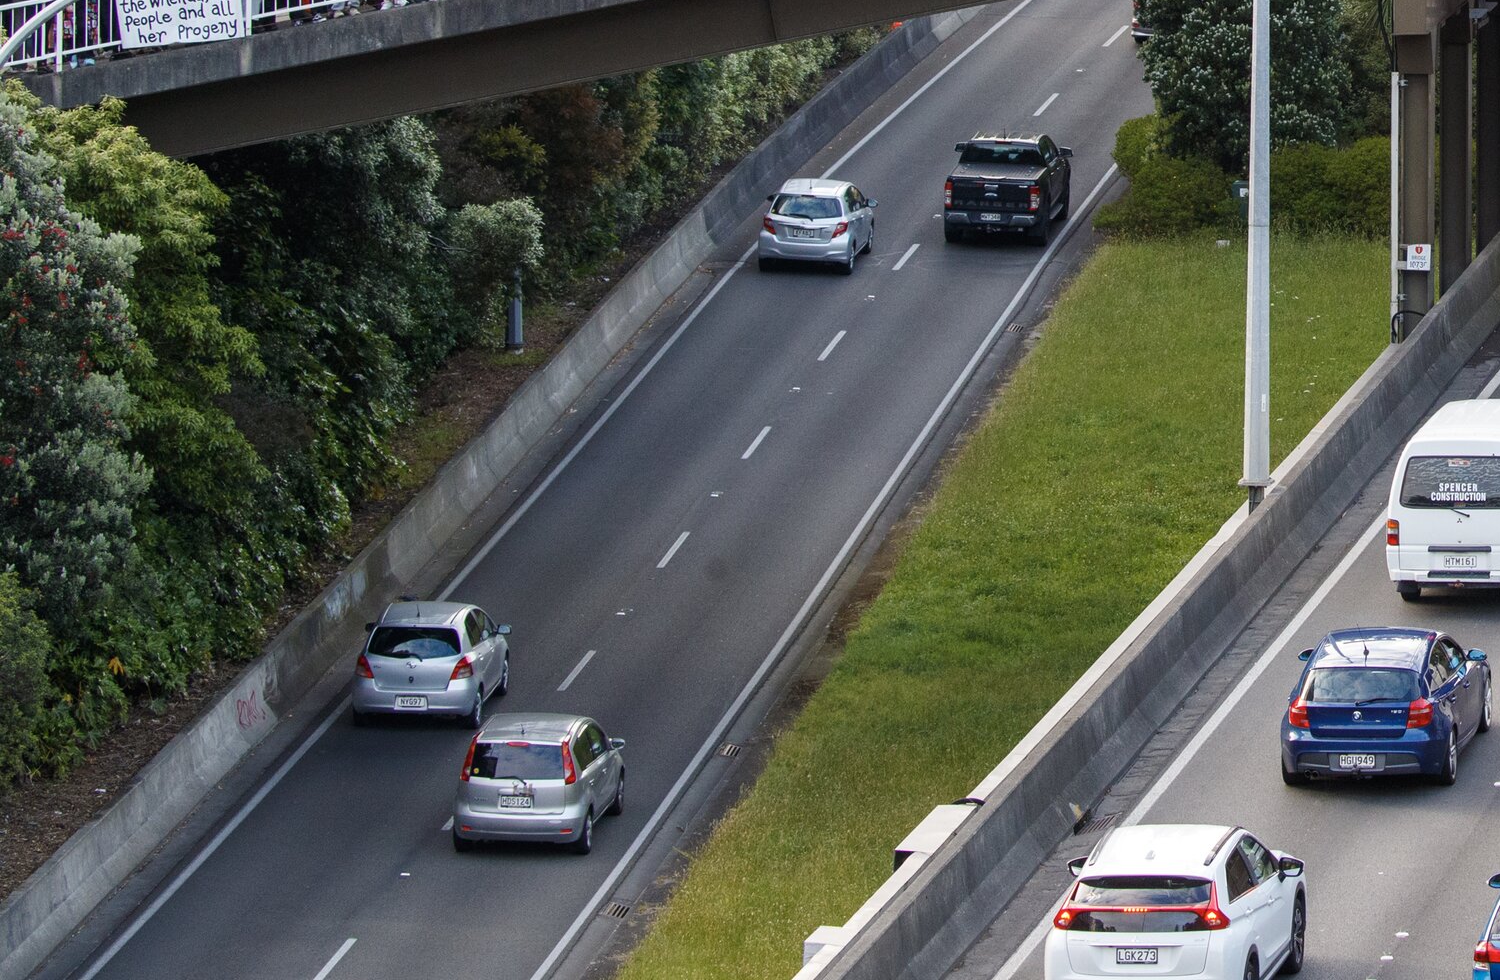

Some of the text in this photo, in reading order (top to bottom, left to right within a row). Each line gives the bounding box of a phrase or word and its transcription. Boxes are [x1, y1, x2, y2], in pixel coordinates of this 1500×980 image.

[178, 3, 206, 21] and
[211, 0, 235, 16] all
[137, 19, 238, 44] her Progeny
[1438, 483, 1478, 492] SPENCER
[1430, 492, 1487, 502] CONSTRUCTION
[1445, 557, 1476, 566] HTM161
[1340, 755, 1374, 765] HGU949
[1118, 949, 1156, 961] LGK273
